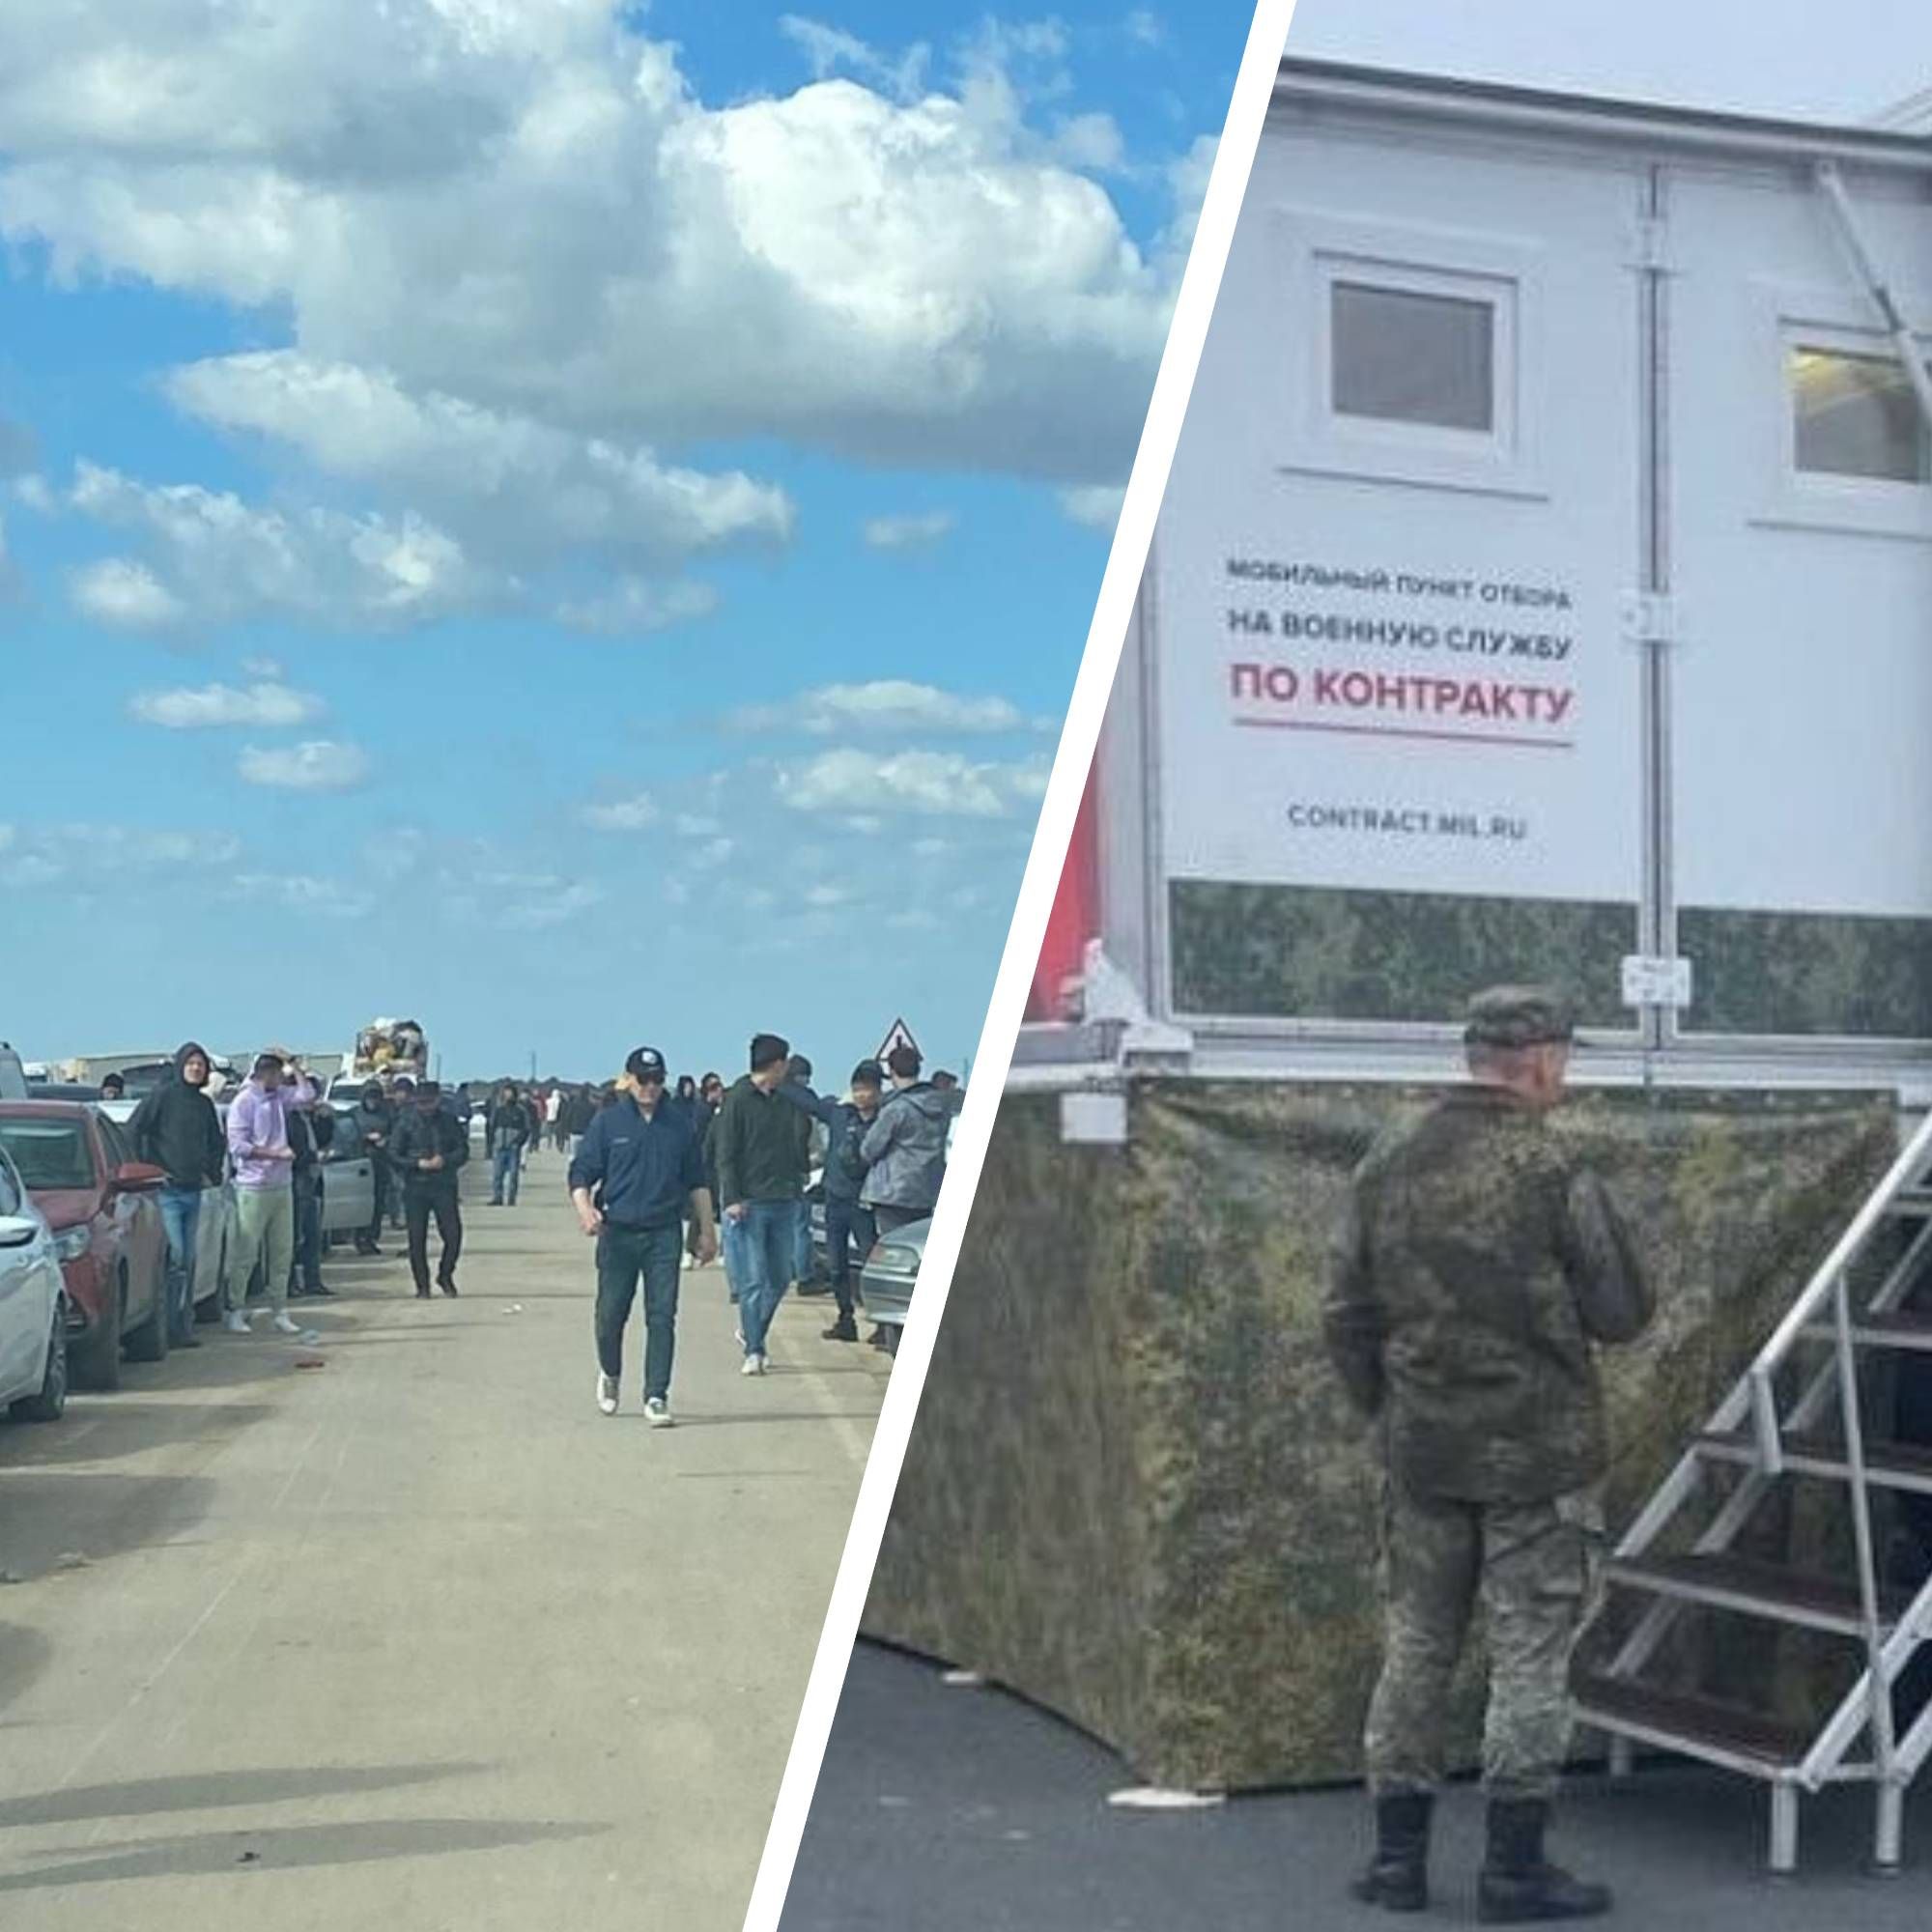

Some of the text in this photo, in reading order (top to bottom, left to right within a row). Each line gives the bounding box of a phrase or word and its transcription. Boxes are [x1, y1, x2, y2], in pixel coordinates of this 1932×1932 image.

[1227, 558, 1573, 610] МОБИЛЬНЫЙ ПУНКТ ОТБОРА
[1228, 610, 1572, 661] НА ВОЕННУЮ СЛУЖБУ
[1231, 664, 1572, 723] ПО КОНТРАКТУ
[1288, 805, 1526, 839] CONTRACT.MIL.RU
